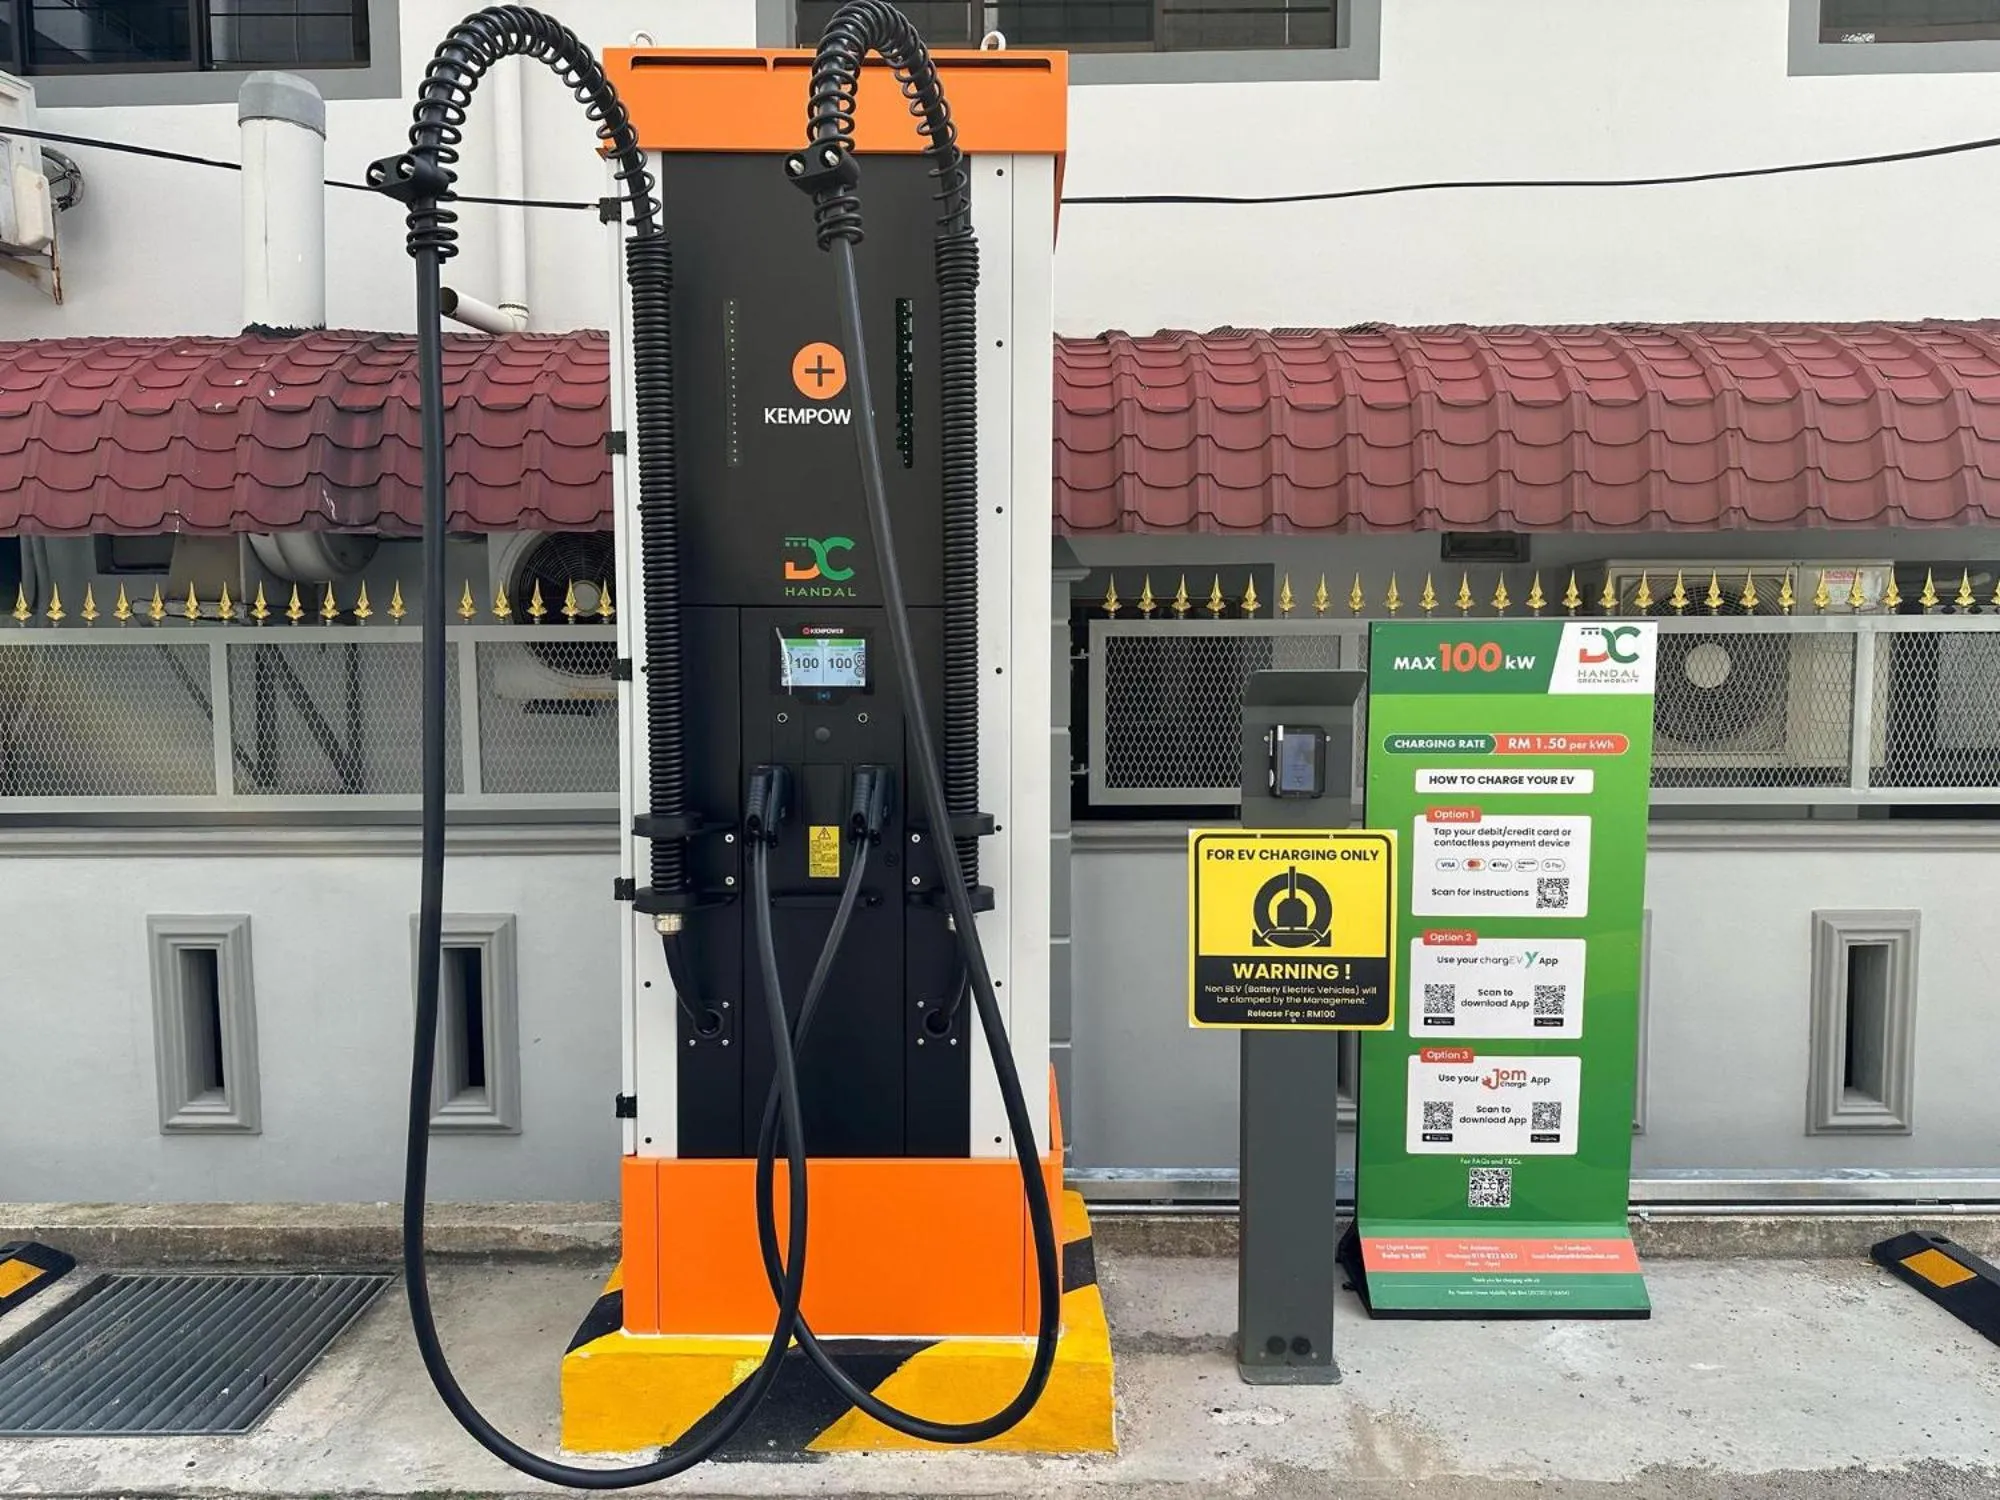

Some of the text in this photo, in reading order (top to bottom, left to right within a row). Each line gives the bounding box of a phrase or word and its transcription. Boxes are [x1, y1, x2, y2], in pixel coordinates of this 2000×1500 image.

[764, 408, 874, 425] KEMPOW
[785, 588, 856, 597] HANDAL
[1394, 642, 1536, 673] MAX 100 kW
[795, 658, 819, 669] 100
[828, 658, 852, 669] 100
[1577, 669, 1639, 678] HANDAL
[1394, 739, 1486, 749] CHARGING RATE
[1508, 738, 1614, 751] RM 1.50 per kWh
[1429, 775, 1574, 785] HOW TO CHARGE YOUR EV
[1434, 810, 1475, 820] Option 1
[1433, 827, 1452, 838] Tap
[1453, 829, 1475, 838] your
[1477, 826, 1535, 836] debit/credit
[1537, 826, 1559, 836] card
[1433, 838, 1570, 849] contactless payment device
[1206, 849, 1379, 861] FOR EV CHARGING ONLY
[1431, 888, 1529, 896] Scan for instructions
[1429, 933, 1472, 943] Option 2
[1437, 956, 1455, 965] Use
[1456, 957, 1478, 967] your
[1539, 957, 1558, 967] App
[1232, 963, 1351, 980] WARNING !
[1205, 985, 1377, 995] Non BEV (Battery Electric Vehicles) will
[1478, 988, 1513, 997] Scan to
[1216, 996, 1368, 1006] be clamped by the Management.
[1460, 999, 1530, 1009] download App
[1247, 1009, 1283, 1018] Release
[1284, 1010, 1301, 1018] Fee
[1306, 1010, 1335, 1018] RM100
[1426, 1051, 1469, 1061] Option 3
[1438, 1068, 1551, 1090] Use your Jom App
[1476, 1105, 1511, 1113] Scan to
[1459, 1116, 1527, 1126] download App
